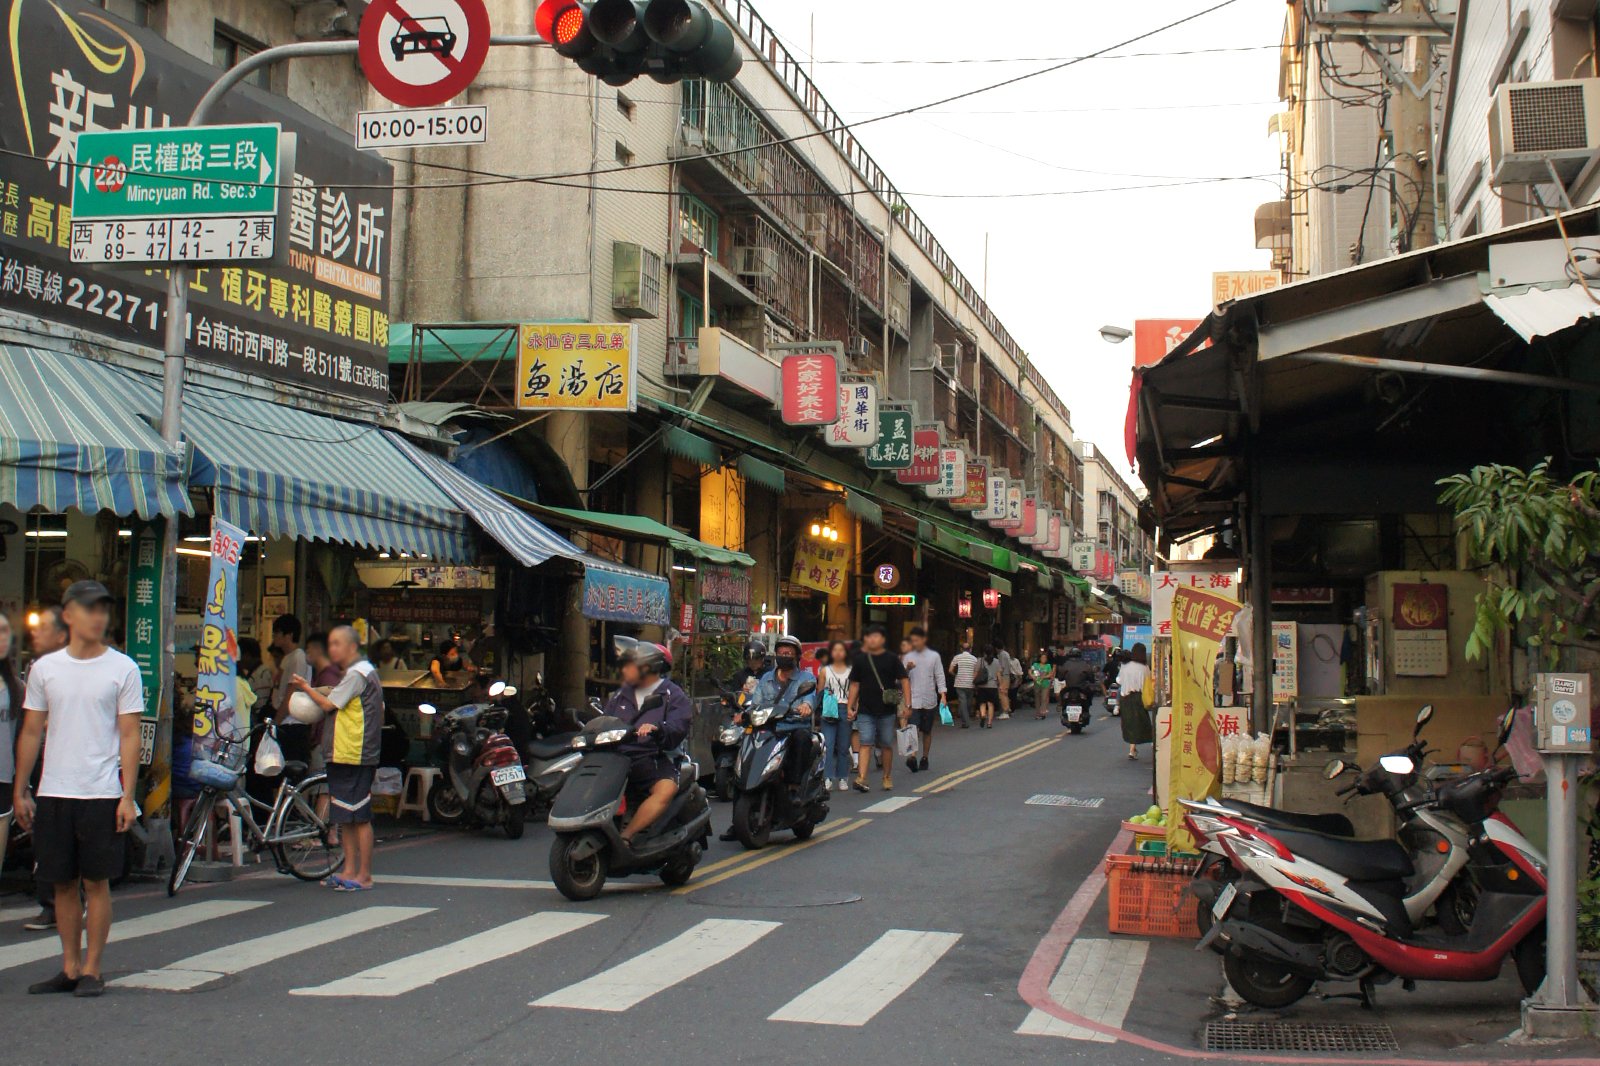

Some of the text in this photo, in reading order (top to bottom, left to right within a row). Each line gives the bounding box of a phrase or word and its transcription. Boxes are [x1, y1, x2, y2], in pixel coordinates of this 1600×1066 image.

[362, 114, 483, 141] 10:00-15:00
[131, 140, 259, 173] 民權路三段
[95, 161, 127, 186] 220
[127, 182, 257, 205] Mincyuan Rd. Sec.3
[73, 223, 94, 244] 西
[146, 221, 166, 238] 44
[239, 220, 248, 237] 2
[252, 219, 274, 241] 東
[146, 242, 166, 259] 47
[227, 240, 247, 257] 17
[317, 259, 353, 287] DENTAL
[353, 272, 382, 296] CLINIC
[0, 256, 64, 305] 約專線
[66, 278, 192, 340] 222711
[221, 266, 389, 347] 植牙專科醫療團隊
[527, 332, 625, 351] 水仙宮三兄弟
[525, 357, 624, 400] 魚湯店
[854, 386, 869, 434] 國華街
[1156, 573, 1233, 590] 大上海
[1160, 713, 1241, 740] 大海
